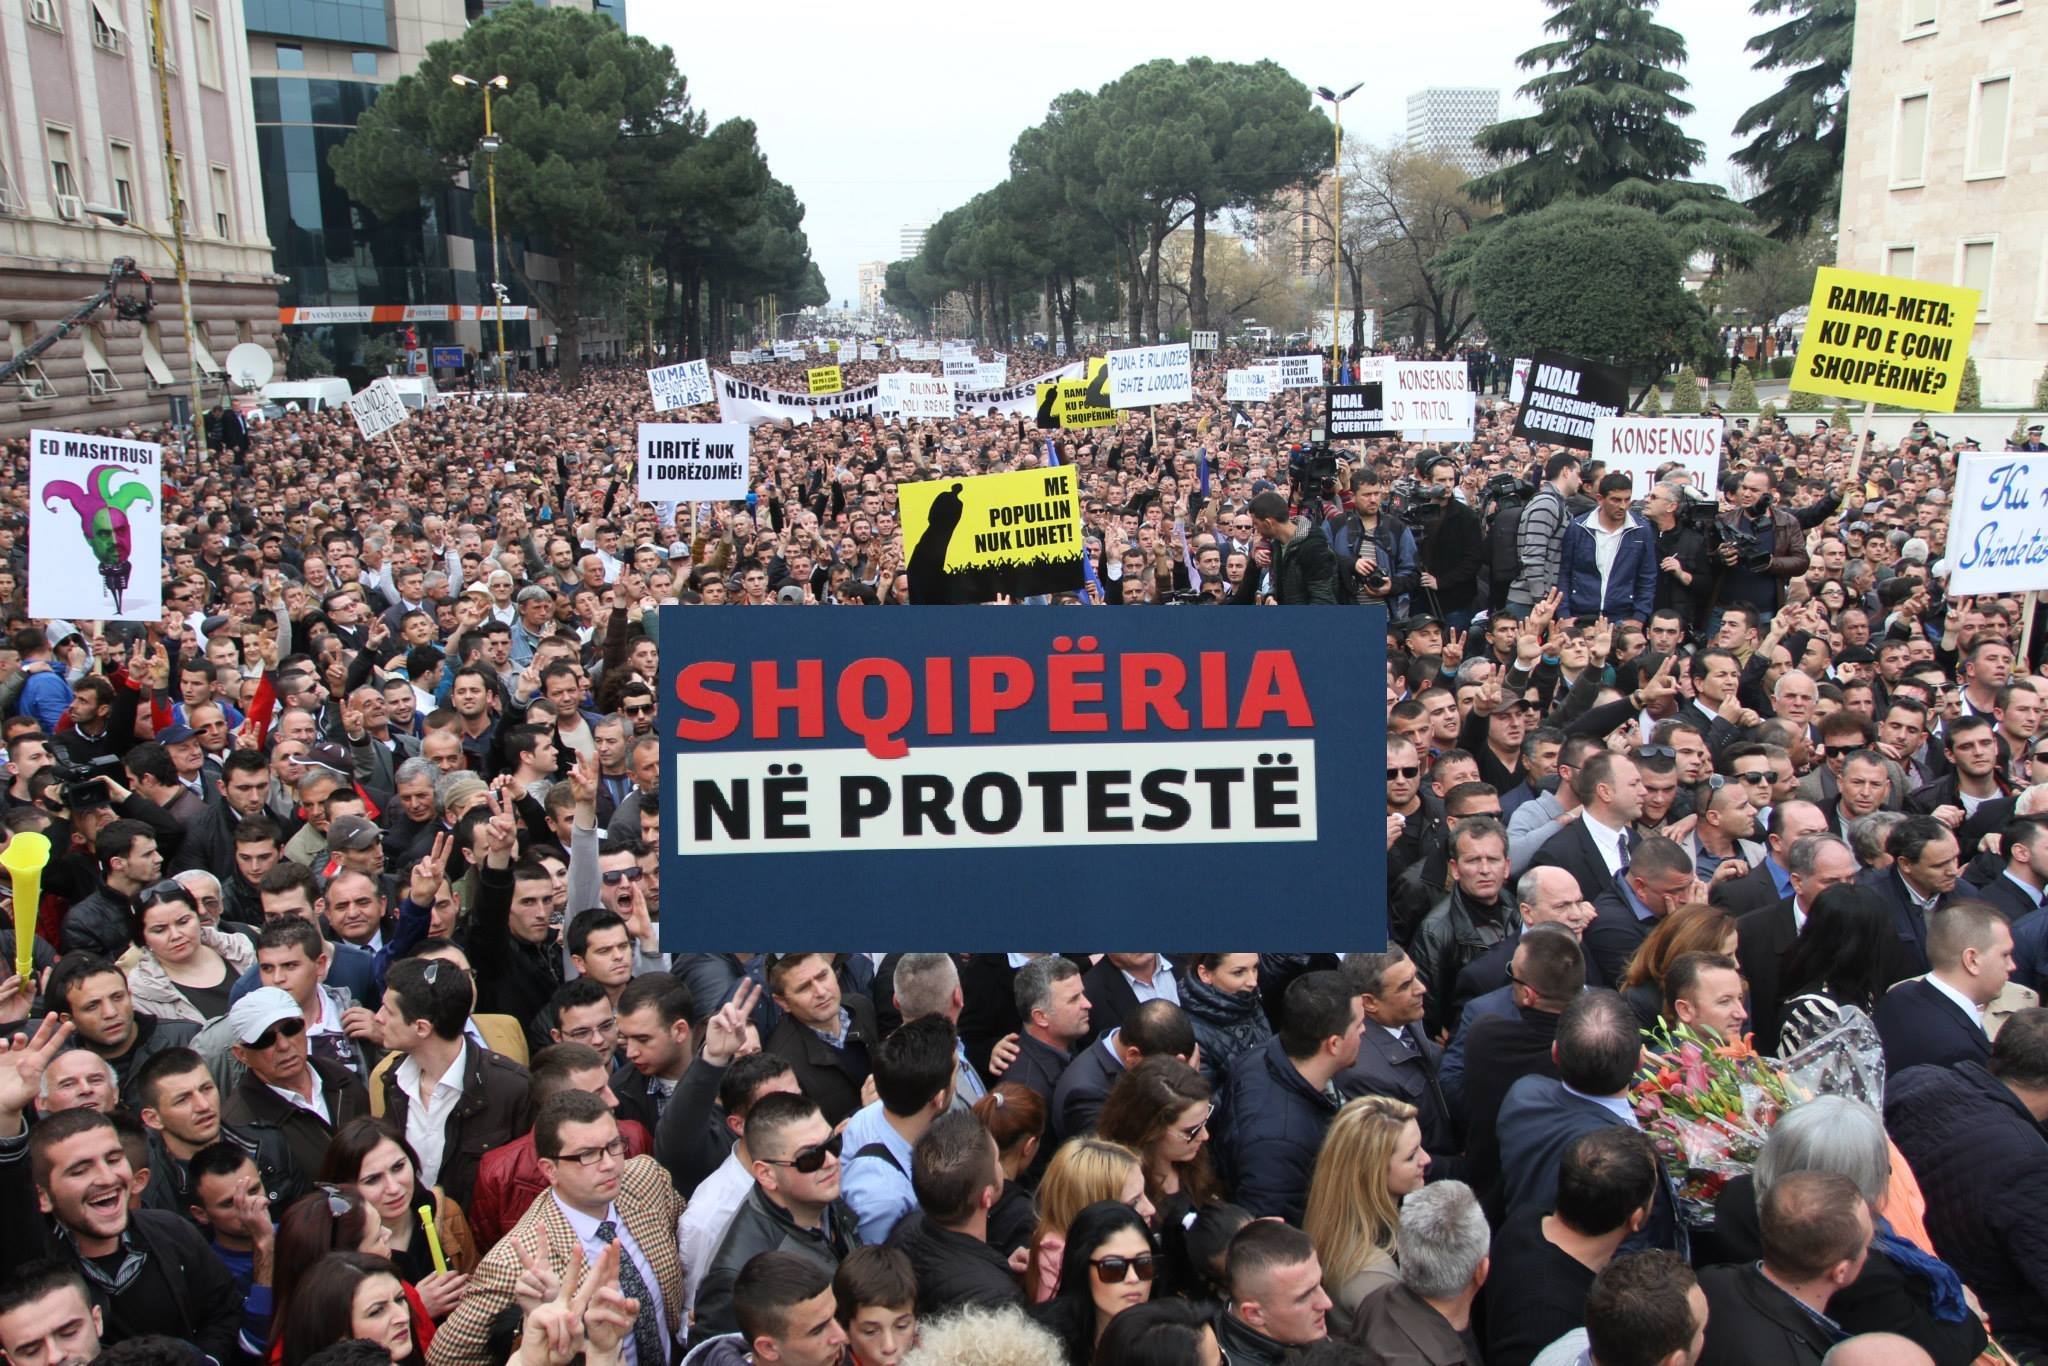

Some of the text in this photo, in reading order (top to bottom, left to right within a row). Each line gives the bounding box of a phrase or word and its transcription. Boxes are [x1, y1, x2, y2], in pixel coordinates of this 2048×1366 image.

[1827, 286, 1955, 328] RAMA-META:
[1818, 320, 1952, 362] KU PO E ÇONI
[1111, 353, 1137, 370] PUNA
[1398, 369, 1465, 391] KONSENSUS
[1535, 363, 1581, 396] NDAL
[1810, 354, 1947, 395] SHQIPËRINË?
[665, 389, 709, 409] FALAS?
[725, 379, 772, 403] NDAL
[1332, 393, 1364, 409] NDAL
[1065, 401, 1077, 411] KU
[1391, 401, 1453, 422] JO TRITOL
[40, 439, 153, 465] ED MASHTRUSI
[648, 438, 734, 459] LIRITË NUK
[1611, 426, 1716, 456] KONSENSUS
[647, 462, 743, 480] I DORËZOJMË!
[1044, 476, 1070, 497] ME
[1981, 462, 2030, 511] Ku
[989, 499, 1071, 528] POPULLIN
[974, 523, 1073, 554] NUK LUHET!
